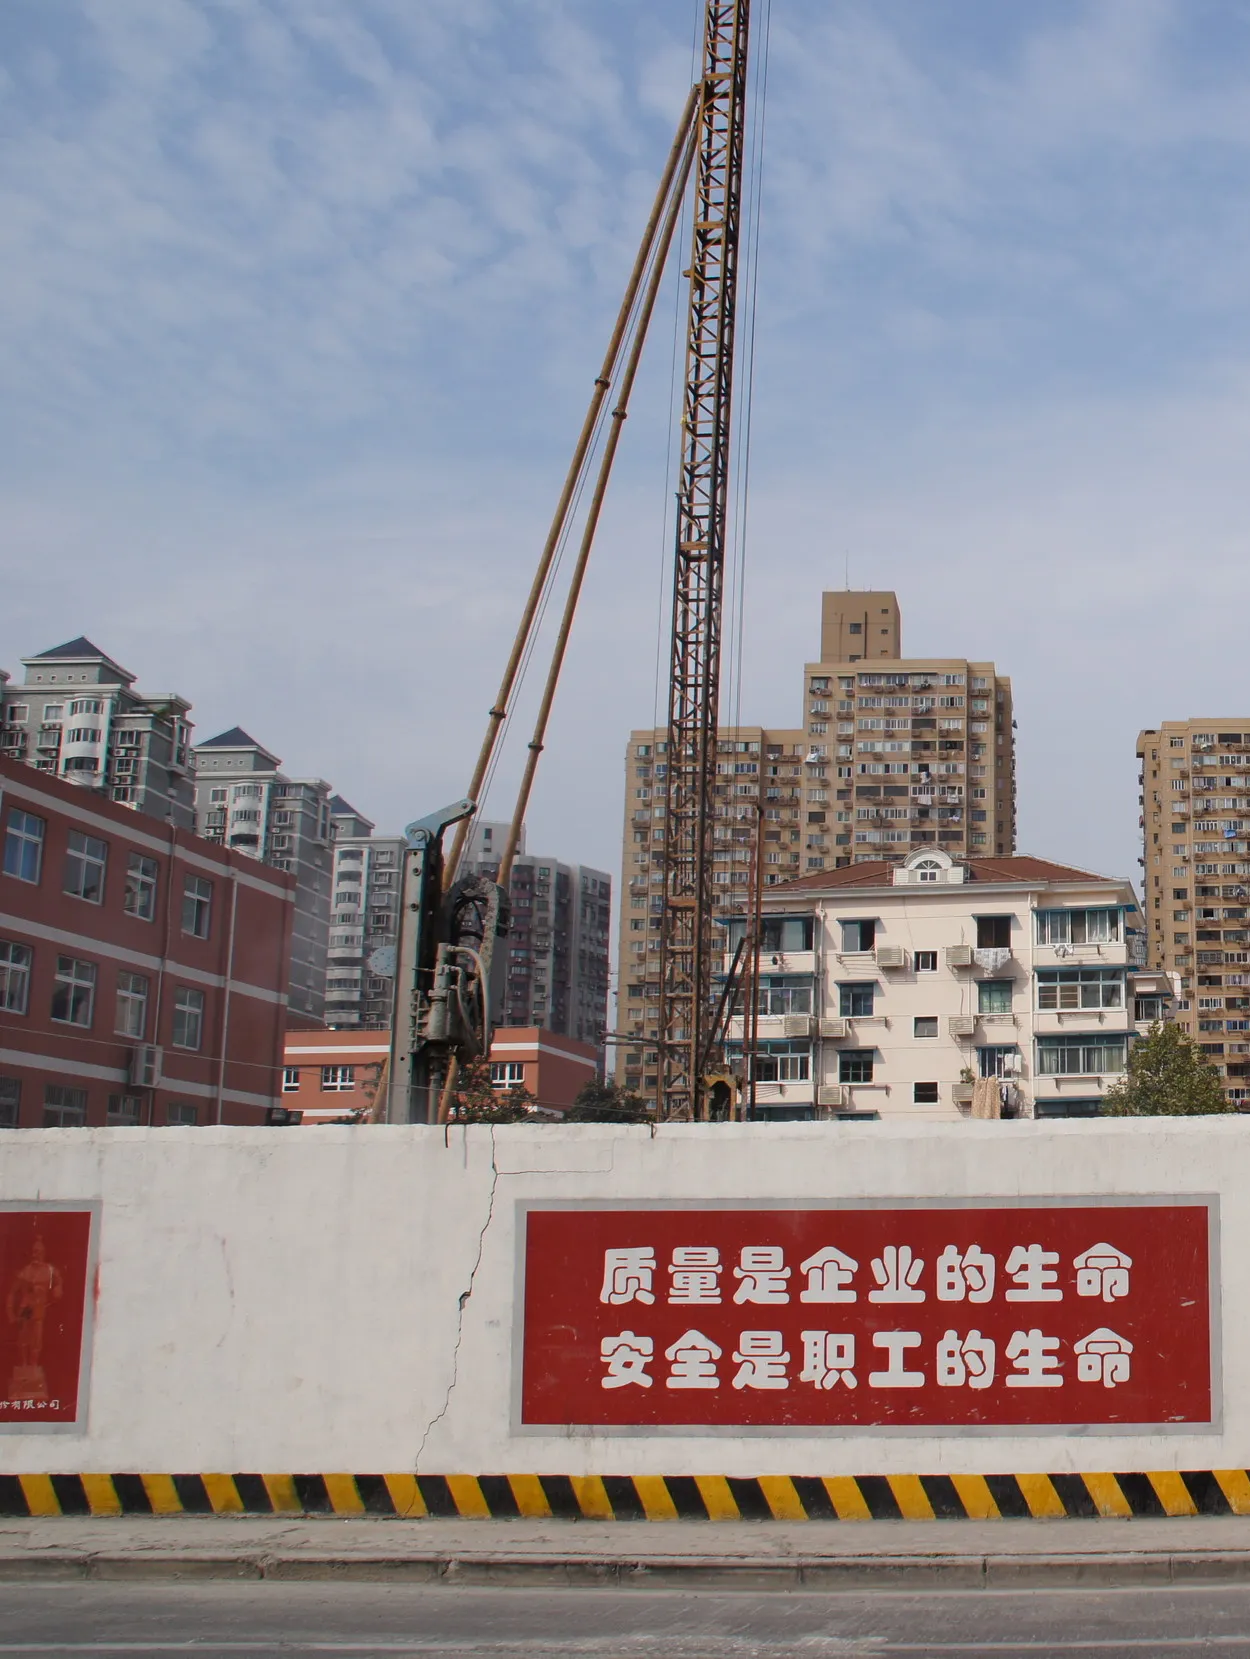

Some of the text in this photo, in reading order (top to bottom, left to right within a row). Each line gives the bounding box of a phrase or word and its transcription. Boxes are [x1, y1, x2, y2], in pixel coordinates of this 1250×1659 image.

[599, 1242, 1134, 1306] 质量是企业的生命
[599, 1327, 1135, 1391] 安全是职工的生命
